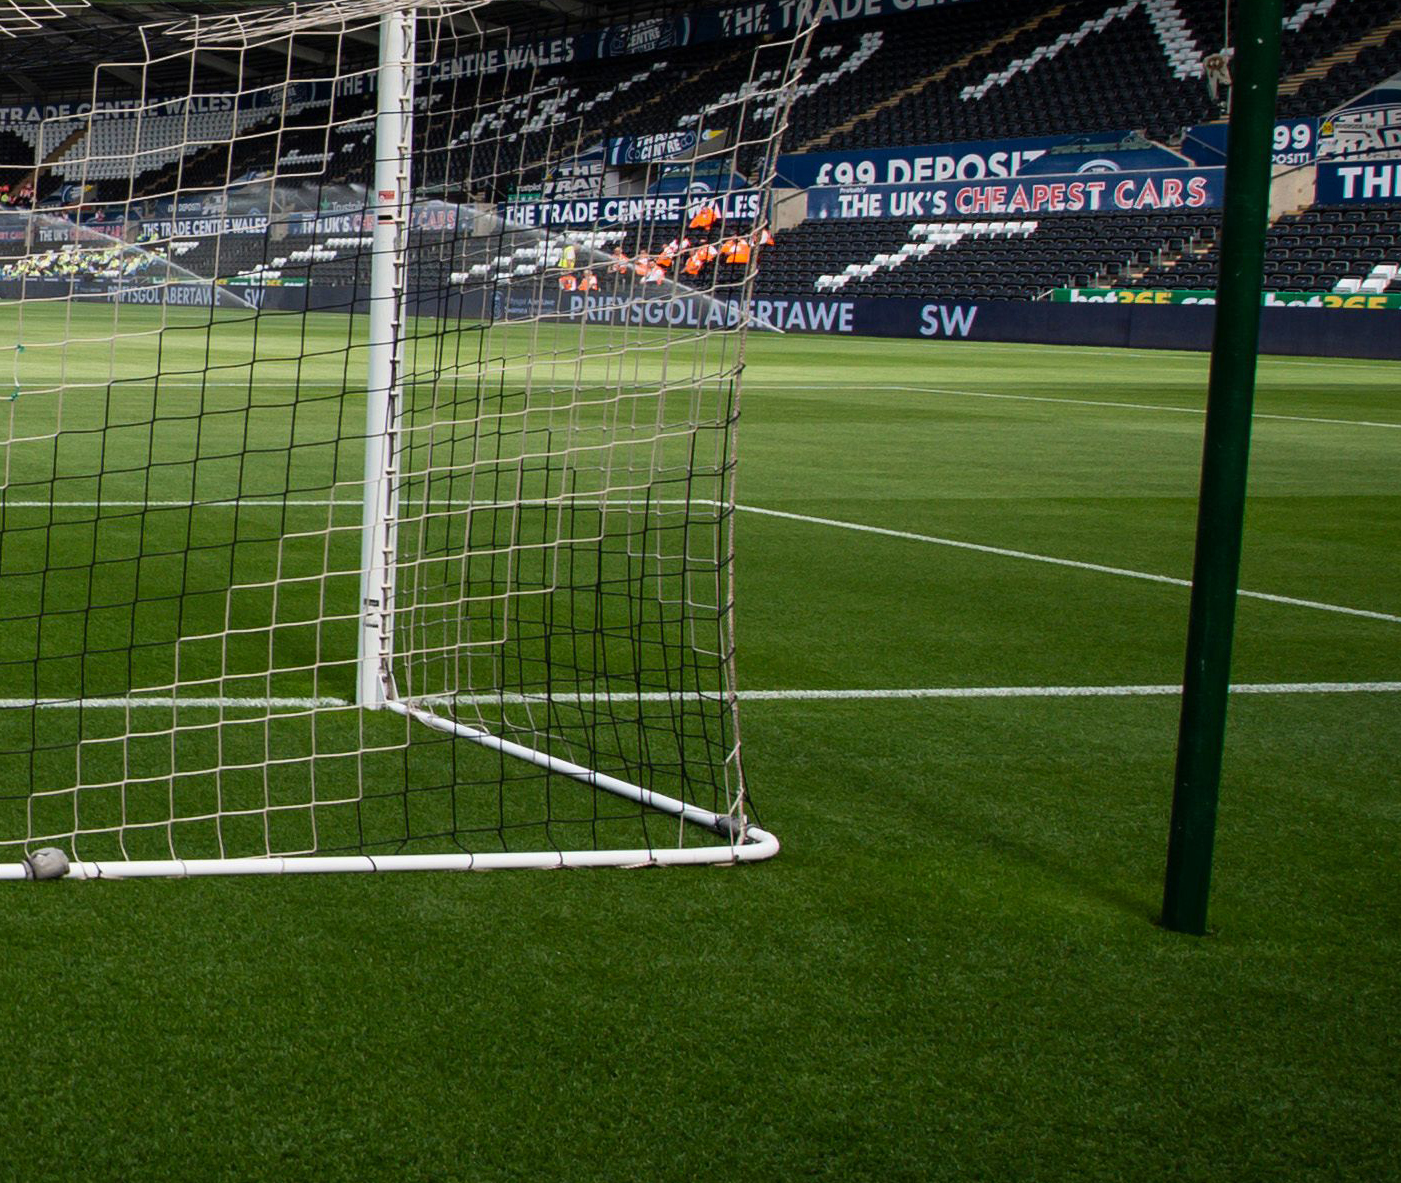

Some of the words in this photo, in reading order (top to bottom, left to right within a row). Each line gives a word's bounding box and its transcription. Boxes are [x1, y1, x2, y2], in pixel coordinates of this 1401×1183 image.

[718, 4, 772, 37] THE
[431, 50, 498, 83] CENTRE
[503, 36, 575, 69] WALES
[337, 73, 364, 97] THE
[79, 97, 160, 122] CENTRE
[163, 90, 233, 116] WALES
[838, 193, 882, 218] THE
[889, 190, 948, 216] UK'S
[955, 180, 1106, 215] CHEAPEST
[1113, 176, 1208, 210] CARS
[839, 186, 867, 195] Probably
[324, 214, 350, 231] UK'S
[418, 209, 455, 230] CARS
[505, 206, 535, 226] THE
[539, 201, 599, 225] TRADE
[604, 198, 681, 221] CENTRE
[39, 230, 53, 242] THE
[141, 221, 160, 237] THE
[160, 220, 192, 237] TRADE
[193, 219, 233, 234] CENTRE
[233, 217, 268, 234] WALES
[244, 288, 266, 308] SW
[570, 295, 698, 326] PRIFYSGOL
[704, 298, 854, 332] ABERTAWE
[919, 303, 979, 337] SW
